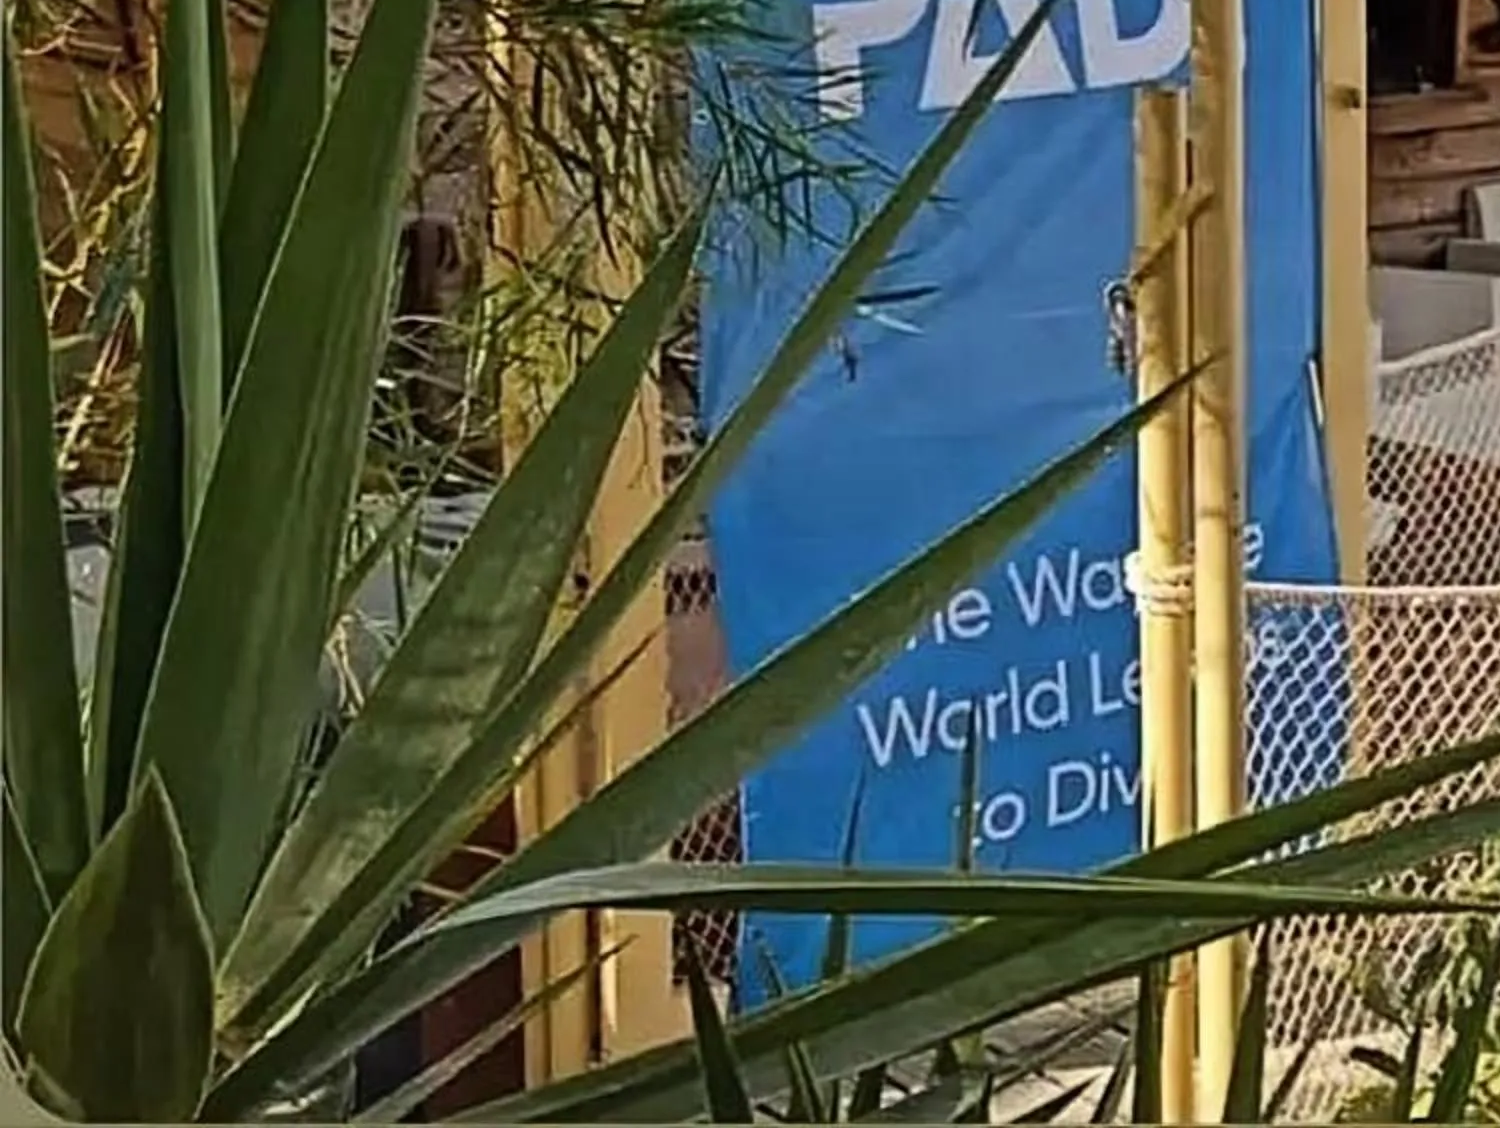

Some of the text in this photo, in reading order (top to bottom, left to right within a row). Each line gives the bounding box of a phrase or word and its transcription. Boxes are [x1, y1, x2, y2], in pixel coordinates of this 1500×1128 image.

[1007, 547, 1142, 627] Wa
[856, 660, 1069, 768] World
[1047, 750, 1142, 828] Div
